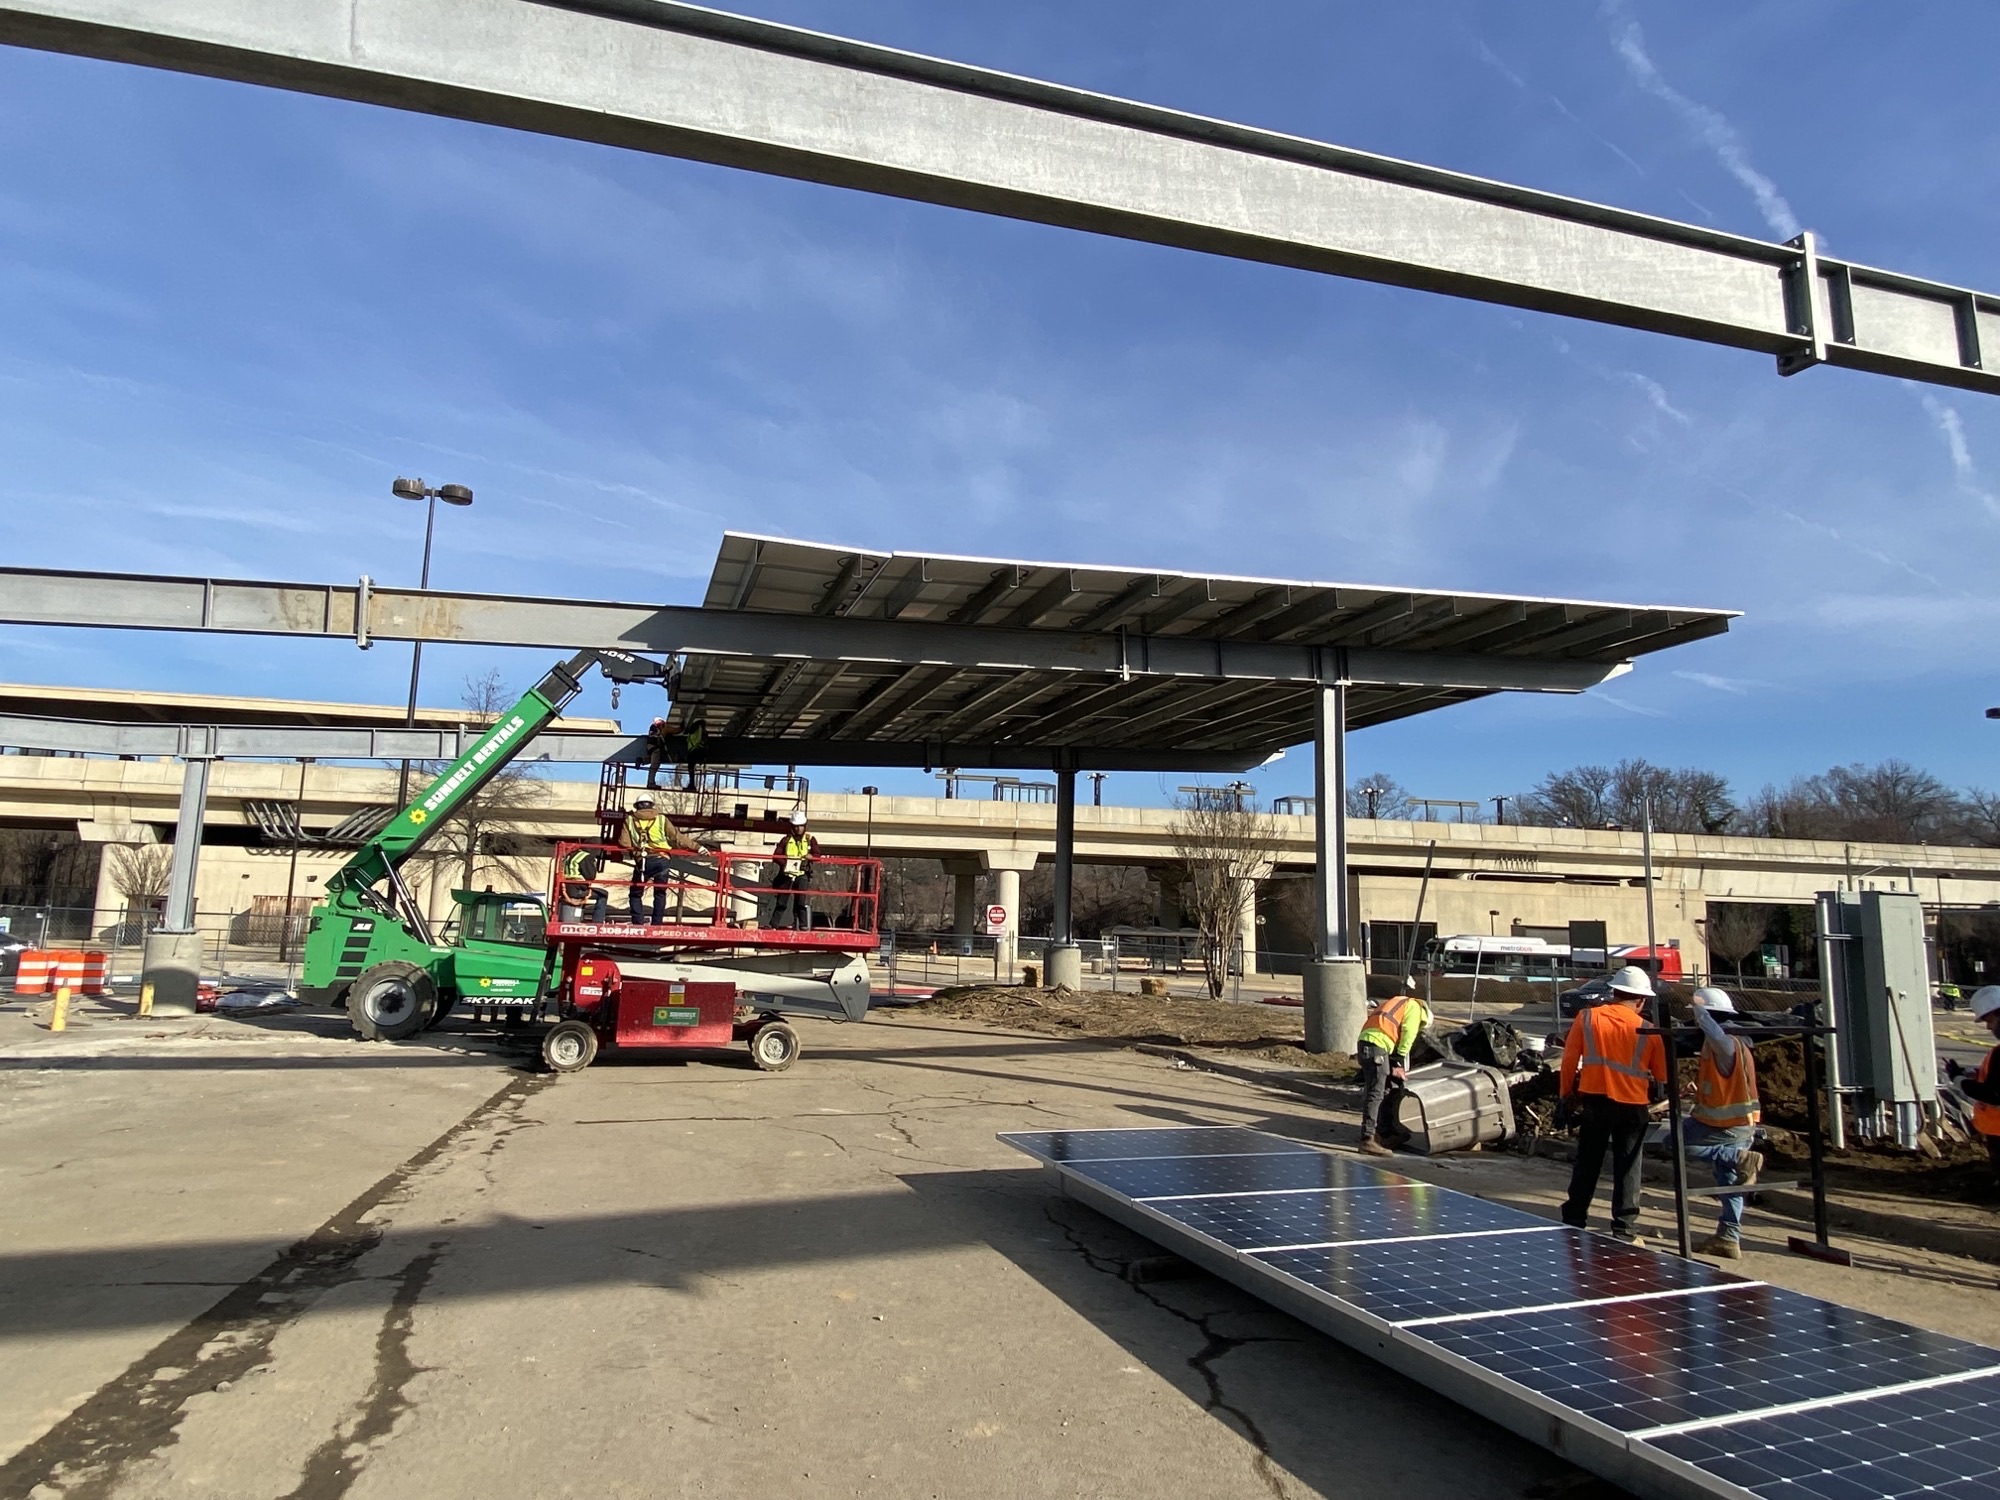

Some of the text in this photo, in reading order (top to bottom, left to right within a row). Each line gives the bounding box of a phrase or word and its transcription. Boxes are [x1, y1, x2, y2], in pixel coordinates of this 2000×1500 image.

[423, 715, 525, 811] SUNBELT RENTALS
[561, 926, 596, 934] mec
